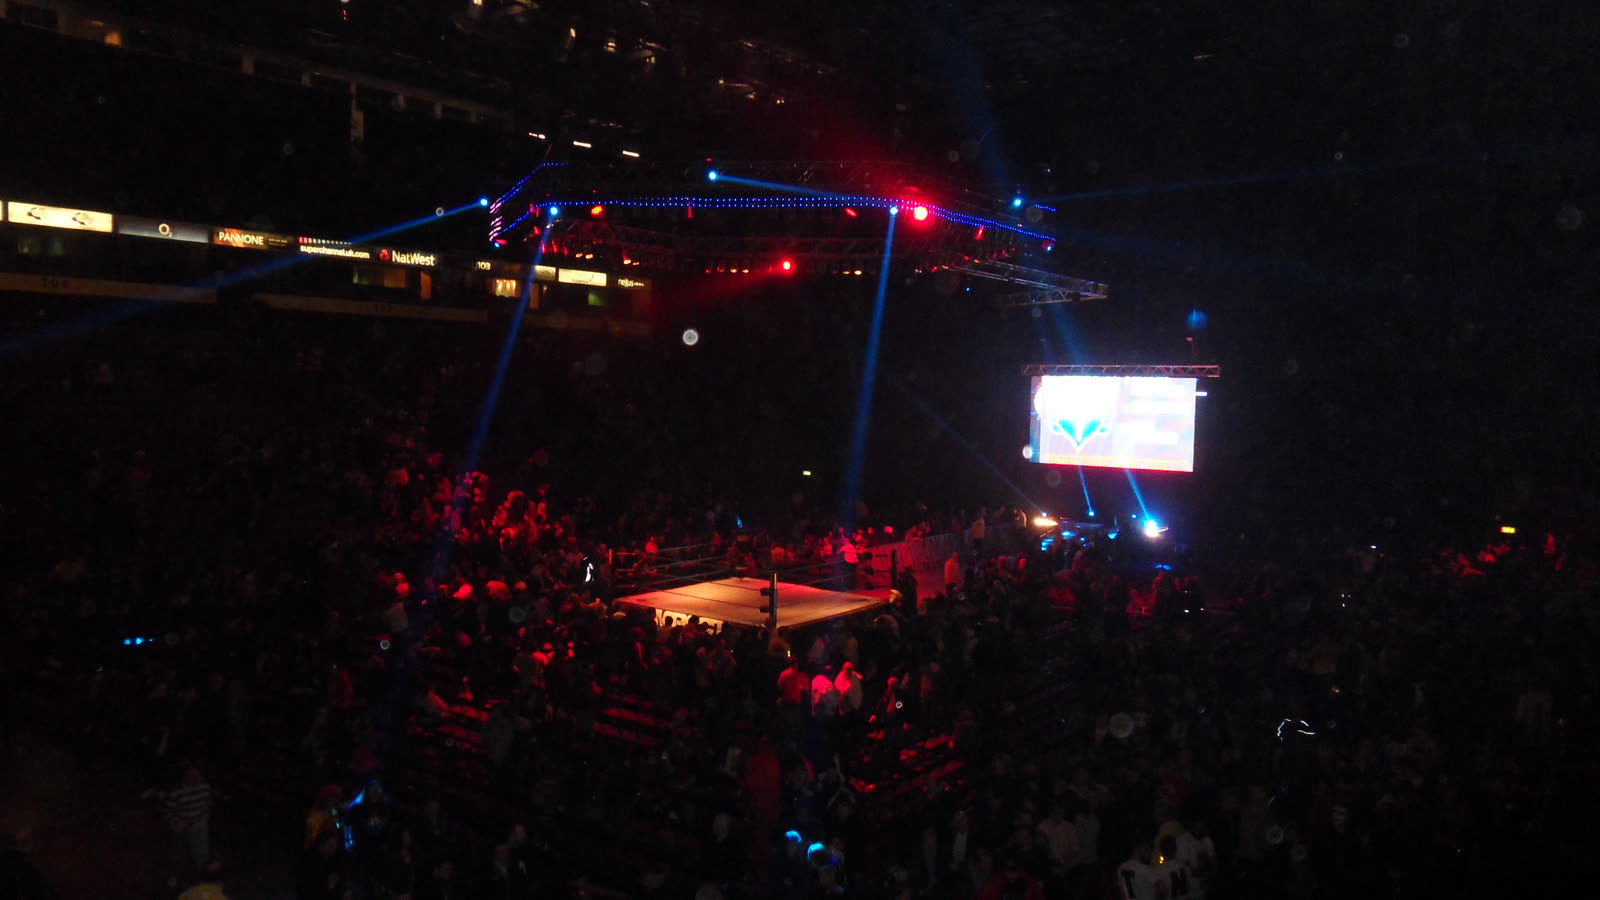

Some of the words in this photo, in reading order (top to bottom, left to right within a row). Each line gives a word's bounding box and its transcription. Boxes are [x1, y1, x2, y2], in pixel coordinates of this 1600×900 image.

[218, 231, 265, 246] PANNONE
[392, 249, 435, 267] NatWest
[477, 261, 491, 271] 103
